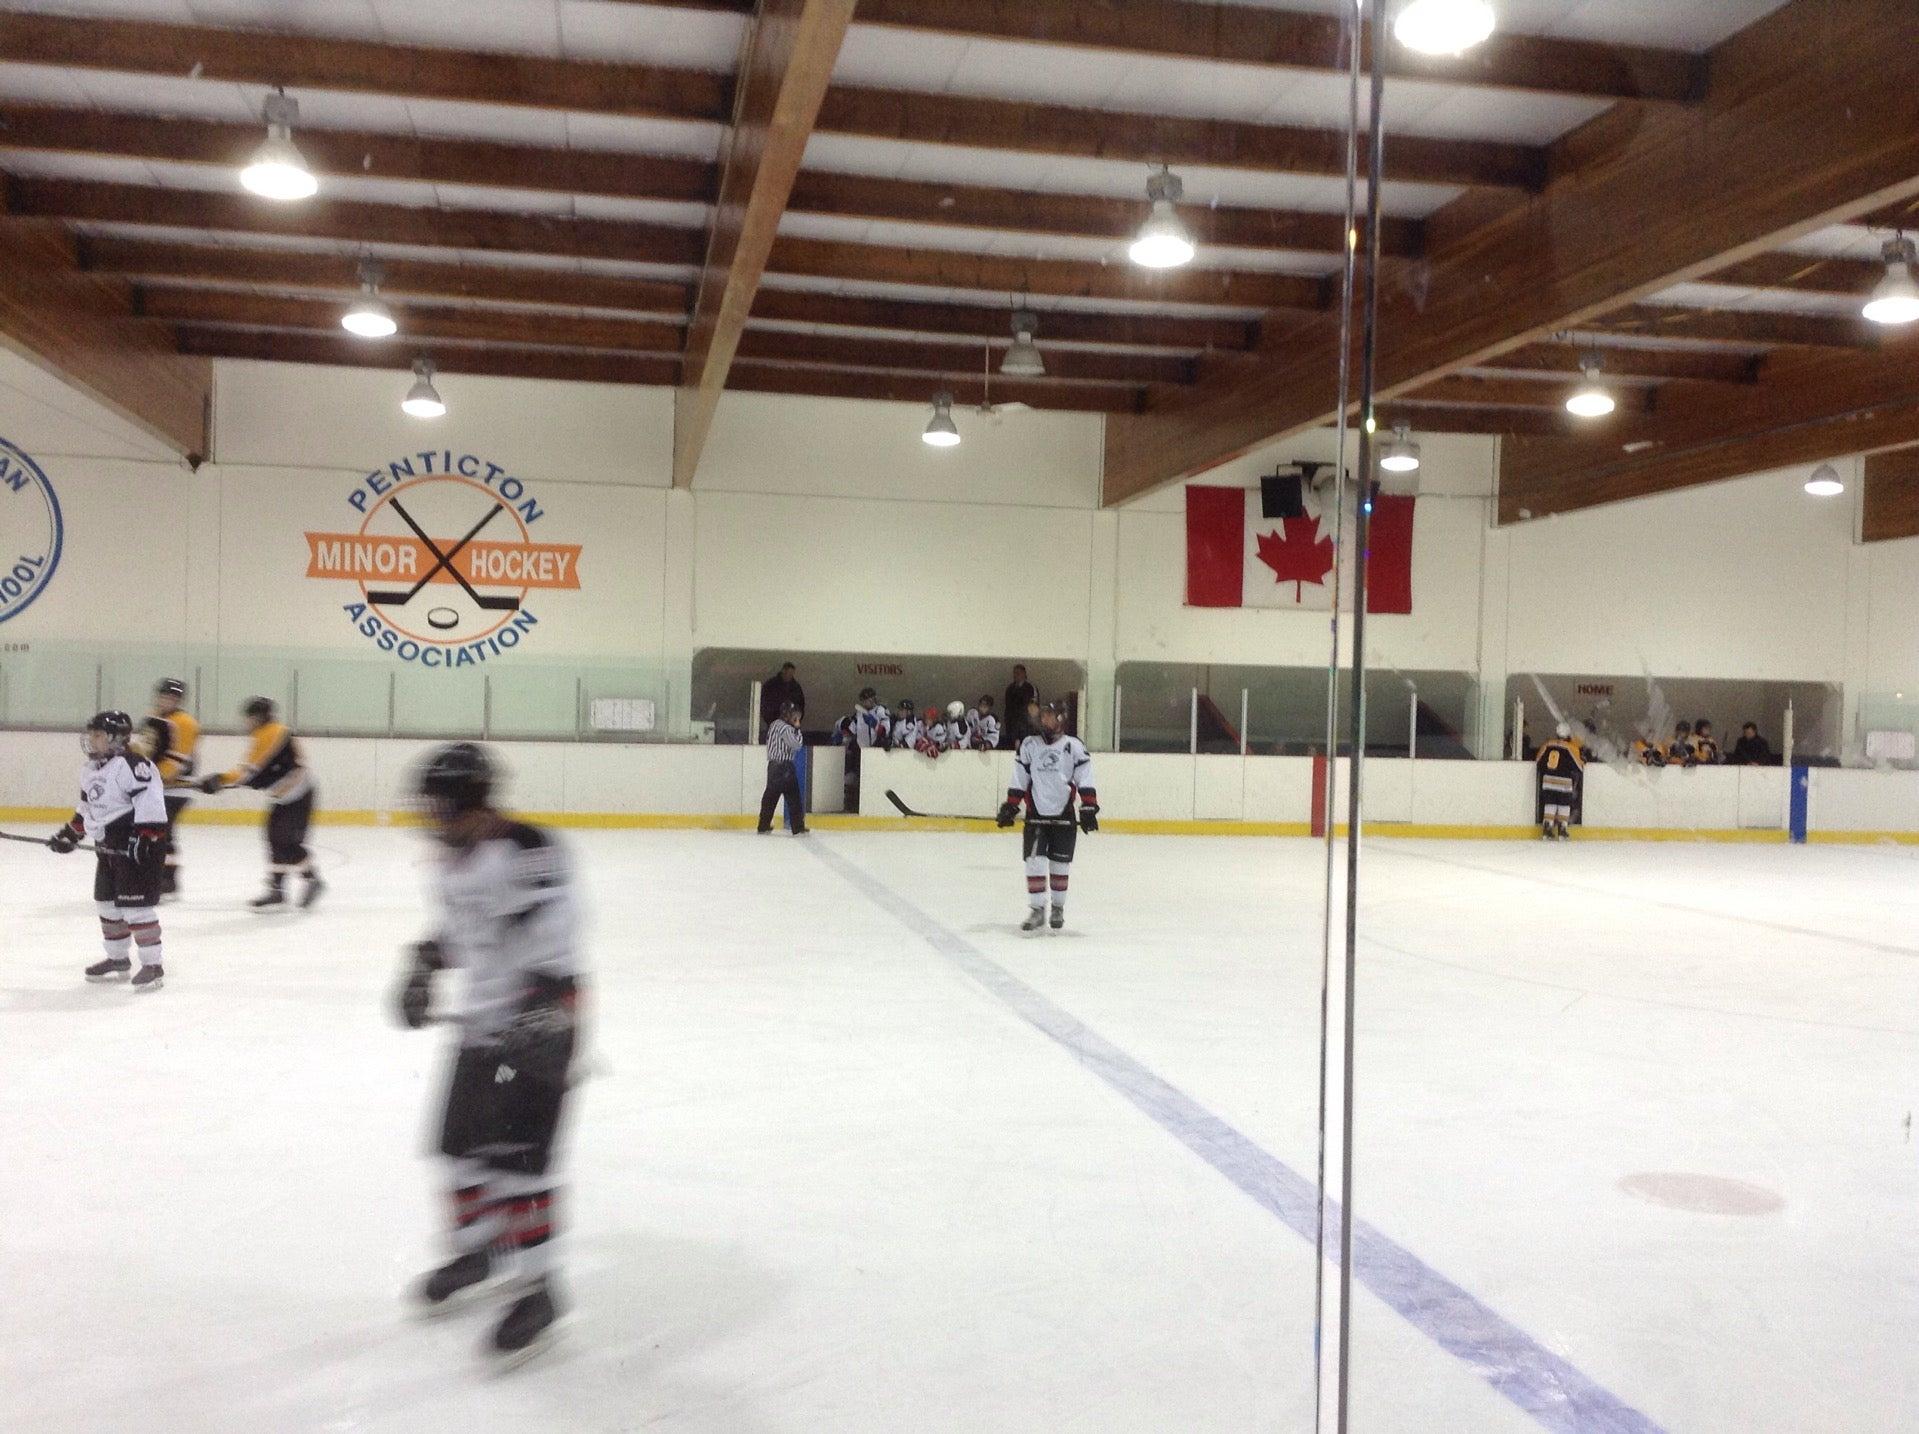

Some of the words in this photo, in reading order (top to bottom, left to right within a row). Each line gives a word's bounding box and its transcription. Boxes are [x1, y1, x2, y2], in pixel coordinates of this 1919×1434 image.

[348, 450, 544, 524] PENTICTON
[317, 541, 417, 574] MINOR
[471, 549, 570, 581] HOCKEY
[343, 602, 538, 668] ASSOCIATION
[857, 664, 903, 674] VISITORS
[1577, 685, 1613, 695] HOME
